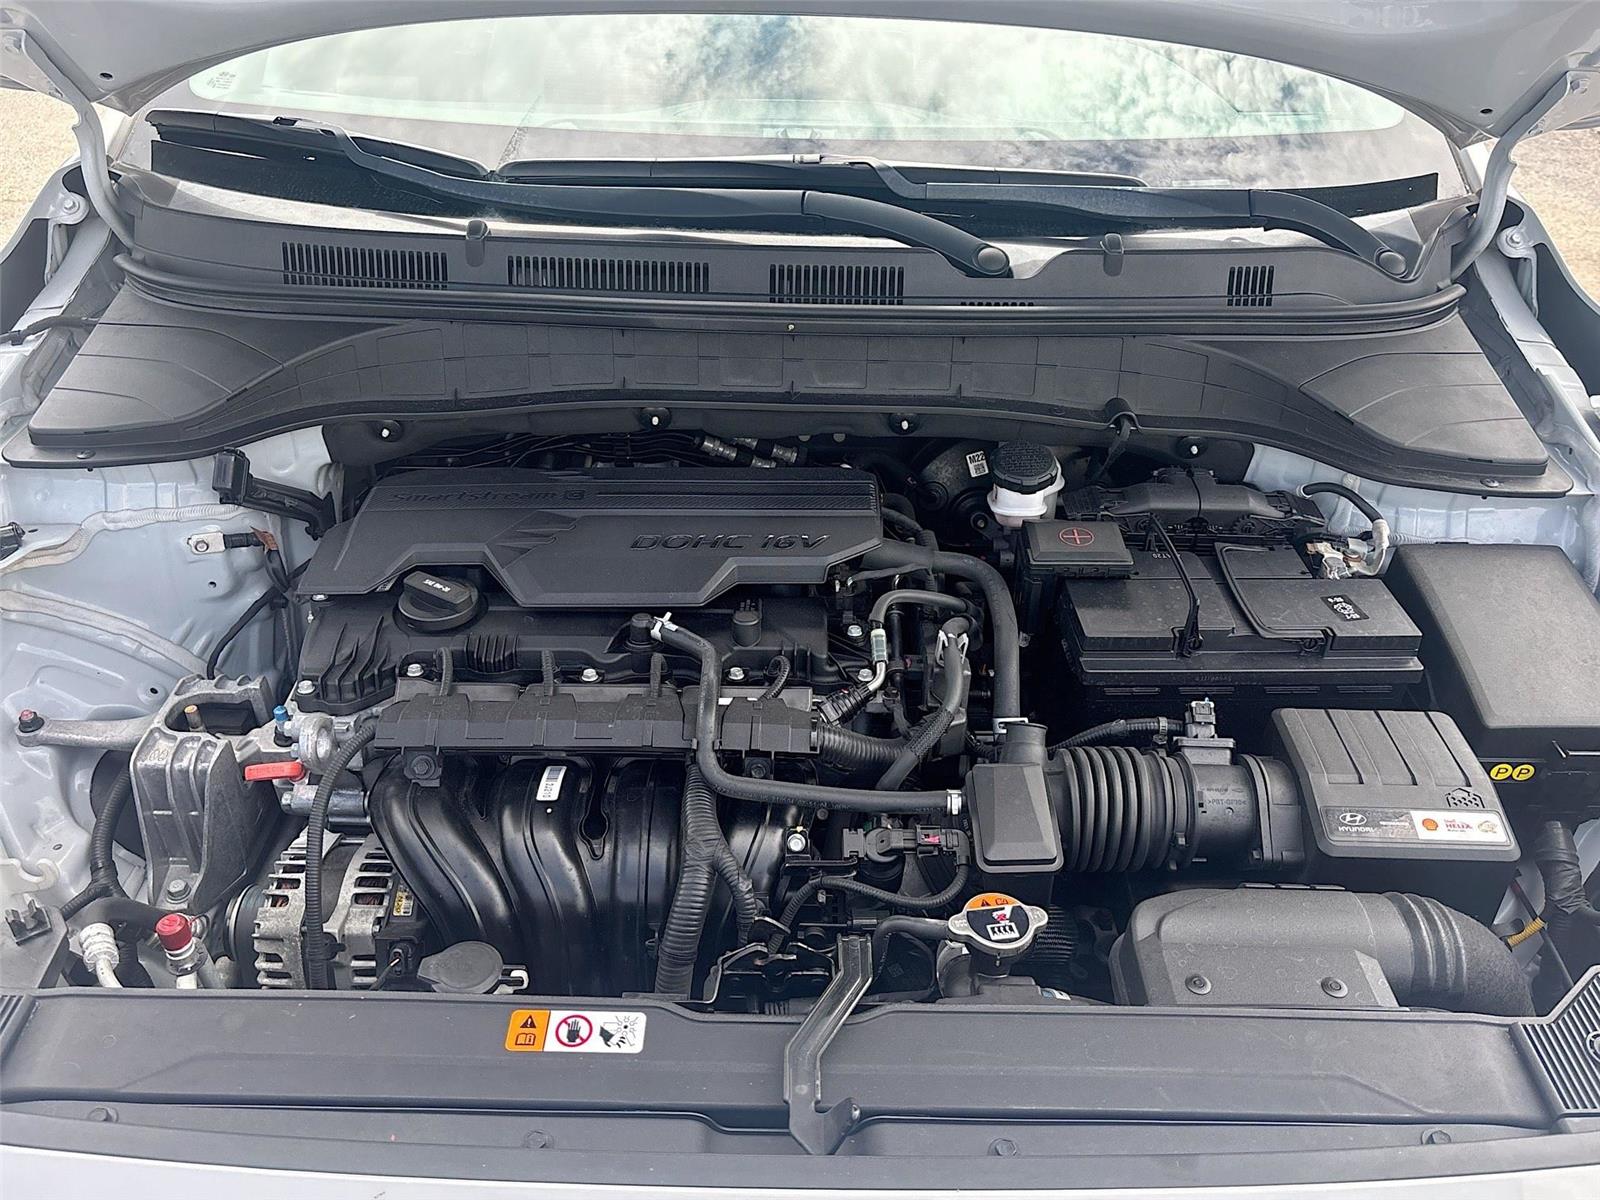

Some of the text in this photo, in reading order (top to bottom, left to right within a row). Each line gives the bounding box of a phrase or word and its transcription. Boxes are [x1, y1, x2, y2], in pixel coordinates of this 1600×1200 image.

[630, 534, 831, 550] DOHC 16V
[1338, 825, 1377, 833] HYUNDAI
